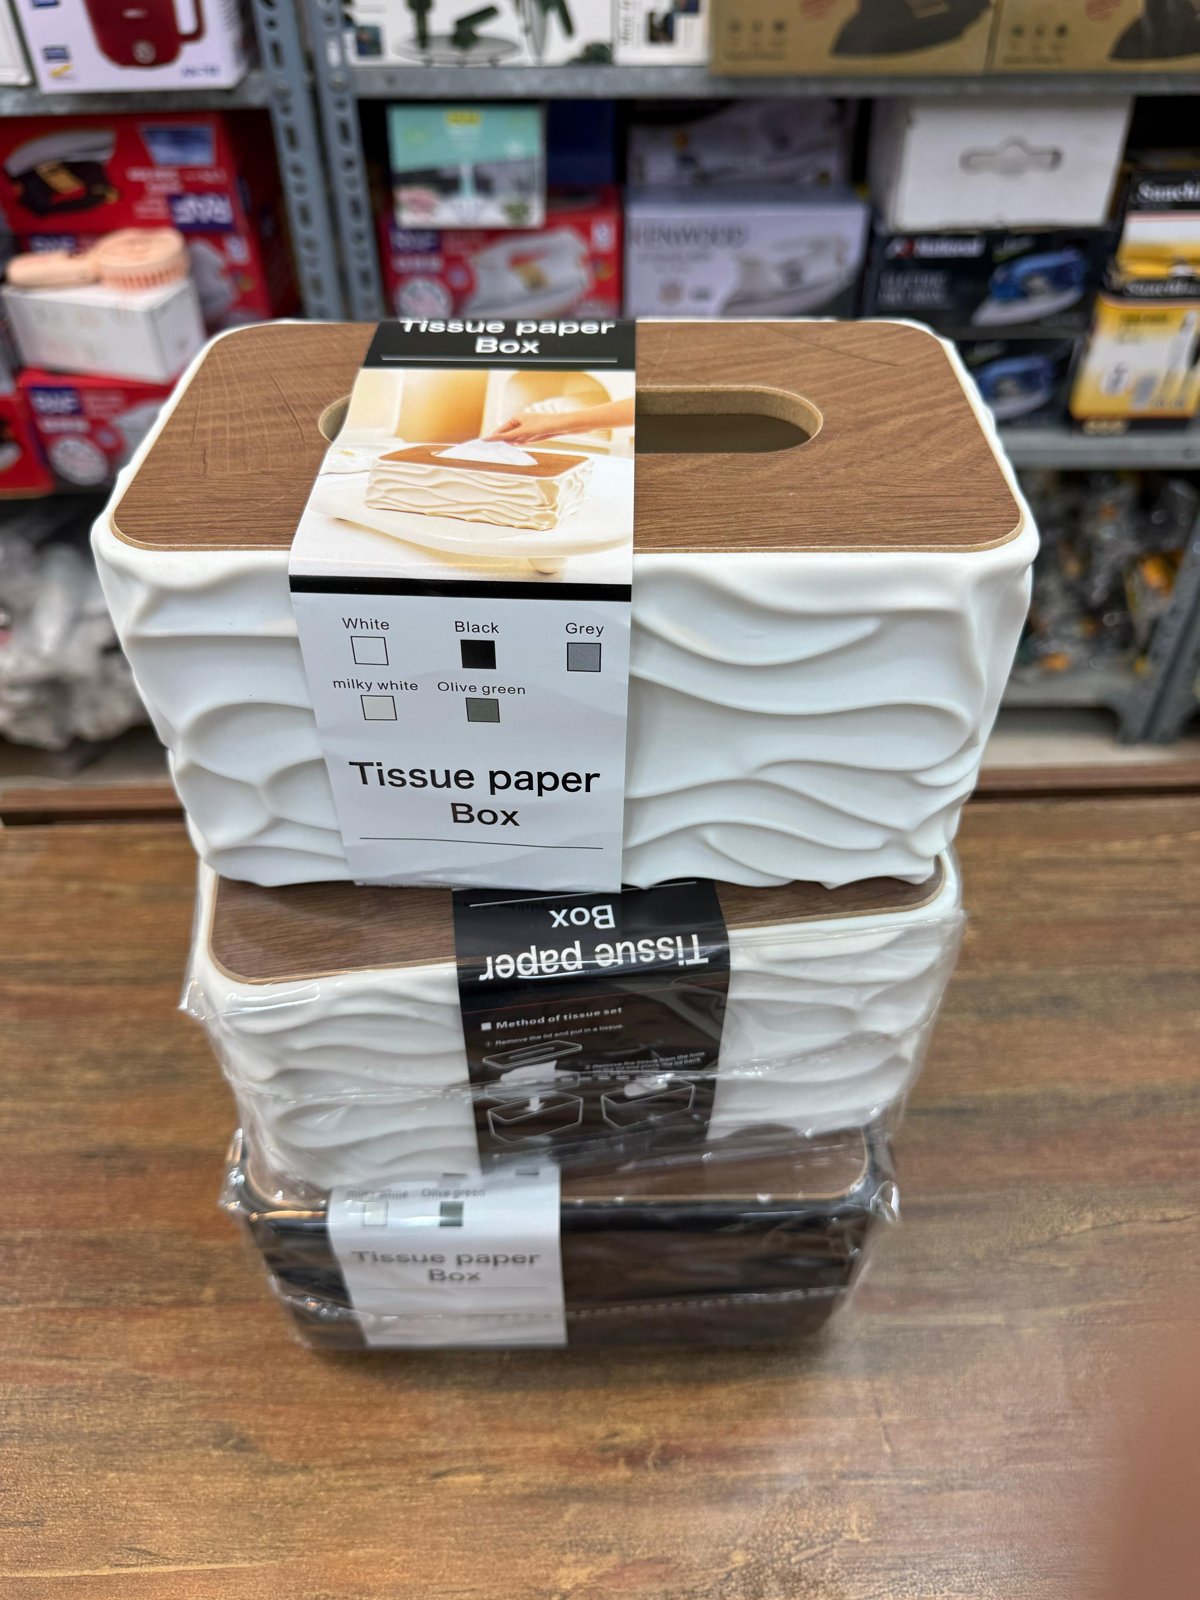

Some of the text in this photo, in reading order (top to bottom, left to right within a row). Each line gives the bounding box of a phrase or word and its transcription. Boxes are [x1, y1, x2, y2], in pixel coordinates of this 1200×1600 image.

[401, 319, 616, 336] Tissue paper
[475, 336, 540, 354] Box
[341, 617, 390, 631] White
[454, 620, 500, 634] Black
[565, 622, 605, 638] Grey
[333, 679, 419, 692] milky white
[437, 681, 526, 696] Olive green
[348, 761, 601, 797] Tissue paper
[450, 802, 520, 827] Box
[549, 904, 616, 930] Box
[478, 934, 709, 981] Tissue paper
[495, 1006, 623, 1029] Method of tissue set
[495, 1036, 528, 1046] Remove
[352, 1250, 542, 1267] Tissue paper
[428, 1268, 481, 1282] Box
